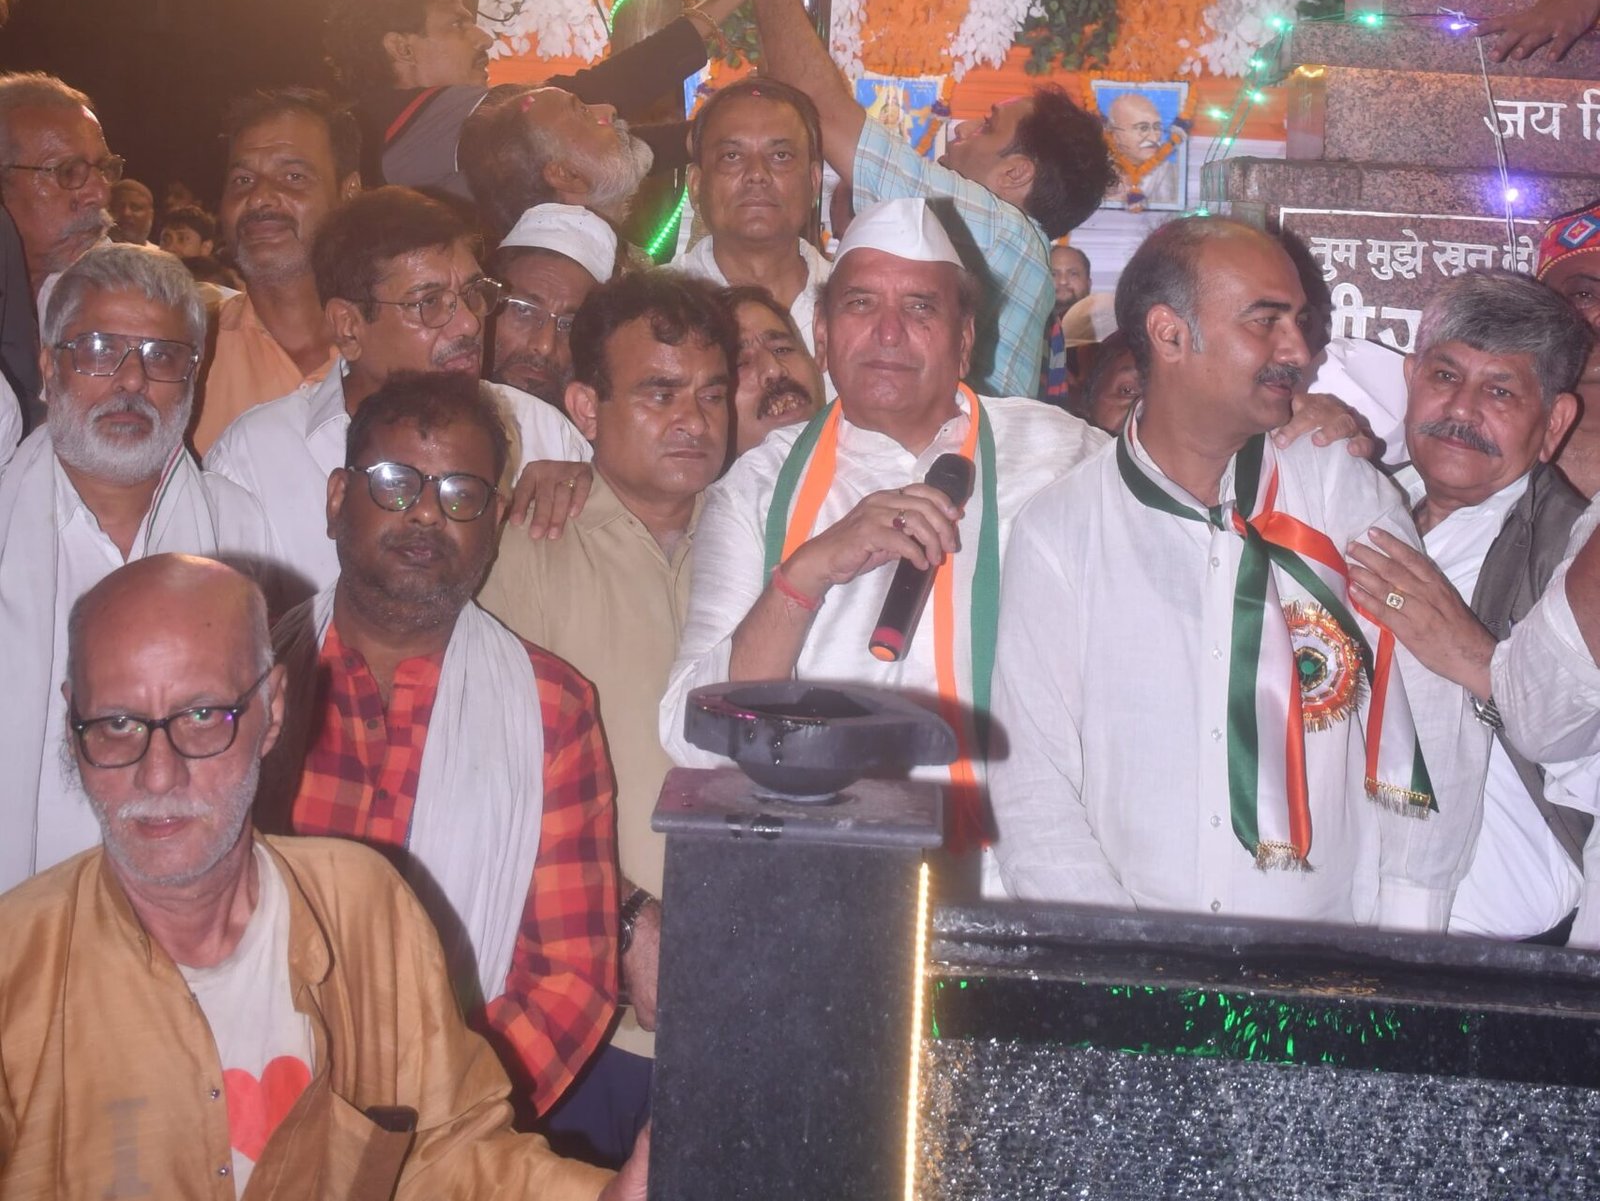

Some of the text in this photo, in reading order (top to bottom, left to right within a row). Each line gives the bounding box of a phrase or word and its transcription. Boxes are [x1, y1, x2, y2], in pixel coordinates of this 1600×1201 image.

[1483, 99, 1568, 141] जय
[1309, 236, 1363, 282] तुम
[1366, 228, 1430, 281] मुझे
